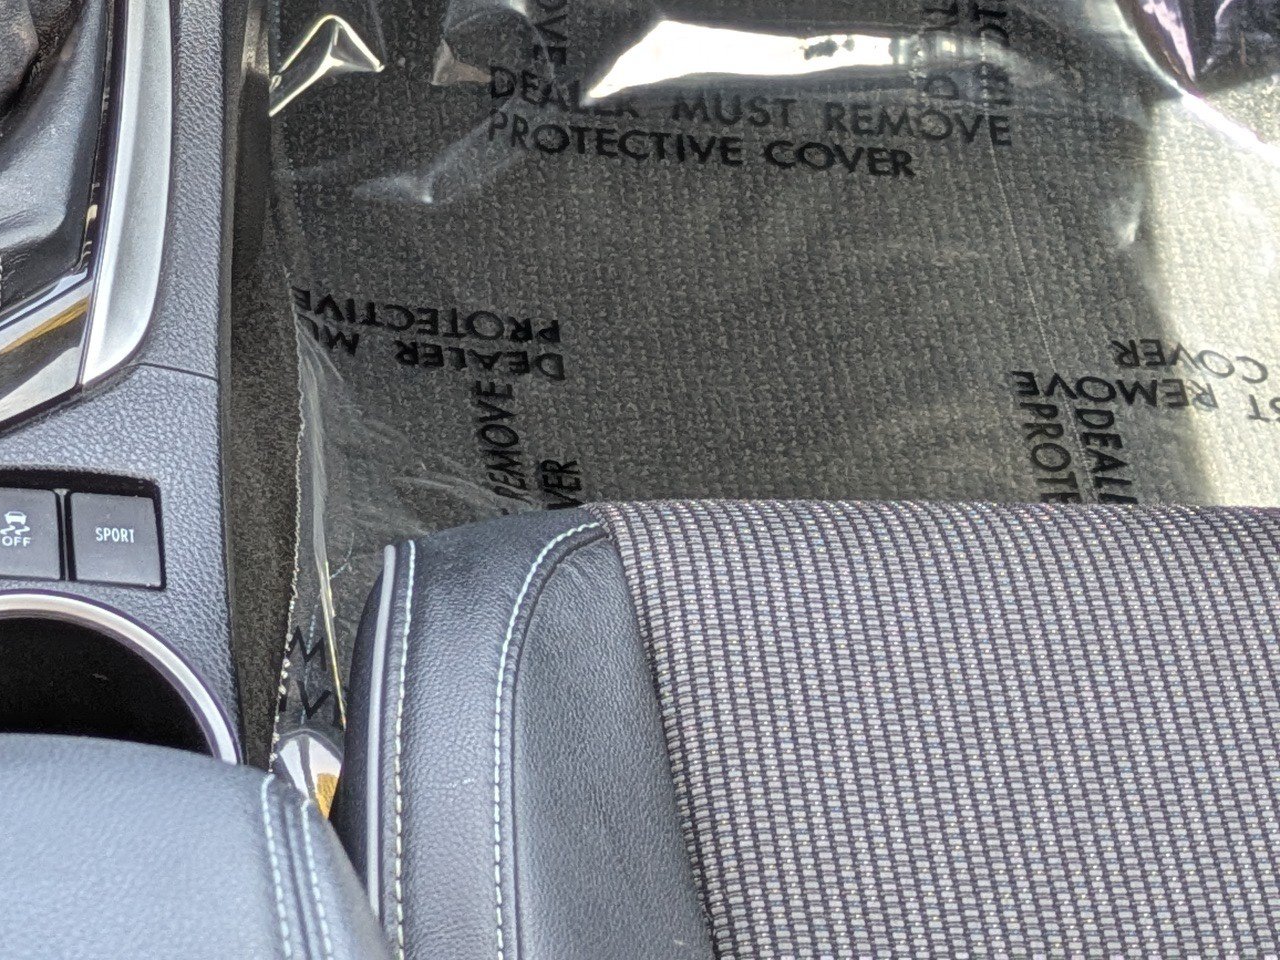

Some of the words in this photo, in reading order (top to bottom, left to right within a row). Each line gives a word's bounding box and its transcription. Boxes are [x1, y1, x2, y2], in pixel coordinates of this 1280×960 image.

[487, 107, 746, 167] PROTECTIVE
[764, 140, 917, 179] COVER
[670, 91, 797, 127] MUST
[823, 100, 1013, 147] REMOVE
[291, 286, 562, 343] PROTECTIVE
[393, 339, 566, 381] DEALER
[1109, 337, 1269, 384] COVER
[1011, 369, 1220, 410] REMOVE
[474, 379, 533, 506] REMOVE
[1019, 401, 1084, 504] PROTE
[538, 458, 584, 511] VER
[1, 536, 32, 547] OFF
[95, 526, 136, 544] SPORT
